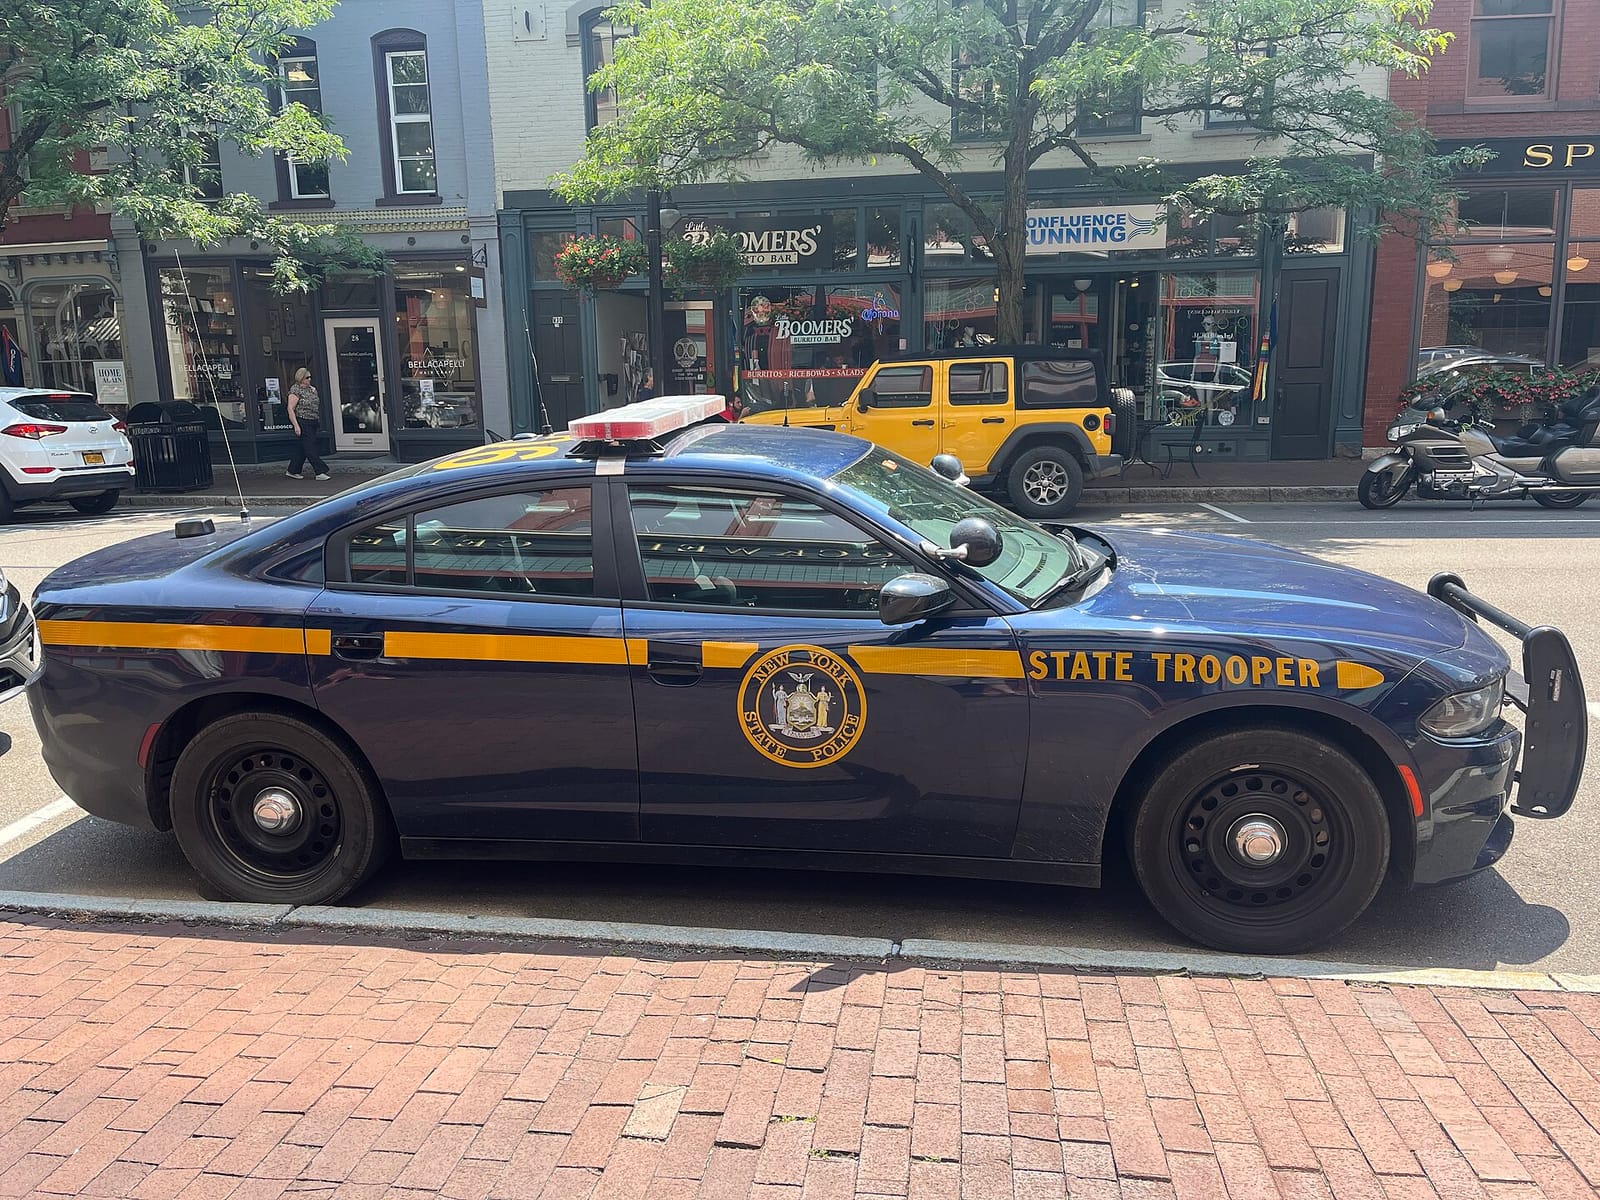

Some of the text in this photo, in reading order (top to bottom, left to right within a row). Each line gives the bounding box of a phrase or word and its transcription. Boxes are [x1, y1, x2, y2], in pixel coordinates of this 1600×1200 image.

[1523, 143, 1595, 168] SP
[1026, 213, 1126, 229] ONFLUENCE
[770, 254, 792, 263] BAR
[861, 308, 900, 321] Corona
[774, 316, 854, 340] BOOMERS'
[178, 364, 233, 372] BELLACAPELLI
[408, 360, 465, 369] BELLACAPELLI
[99, 368, 122, 377] HOME
[747, 370, 783, 378] BURRITOS
[806, 369, 831, 377] BOWLS
[836, 368, 864, 376] SALADS
[752, 650, 853, 689] NEW YORK
[1028, 651, 1321, 688] STATE TROOPER
[743, 711, 860, 762] STATE POLICE
